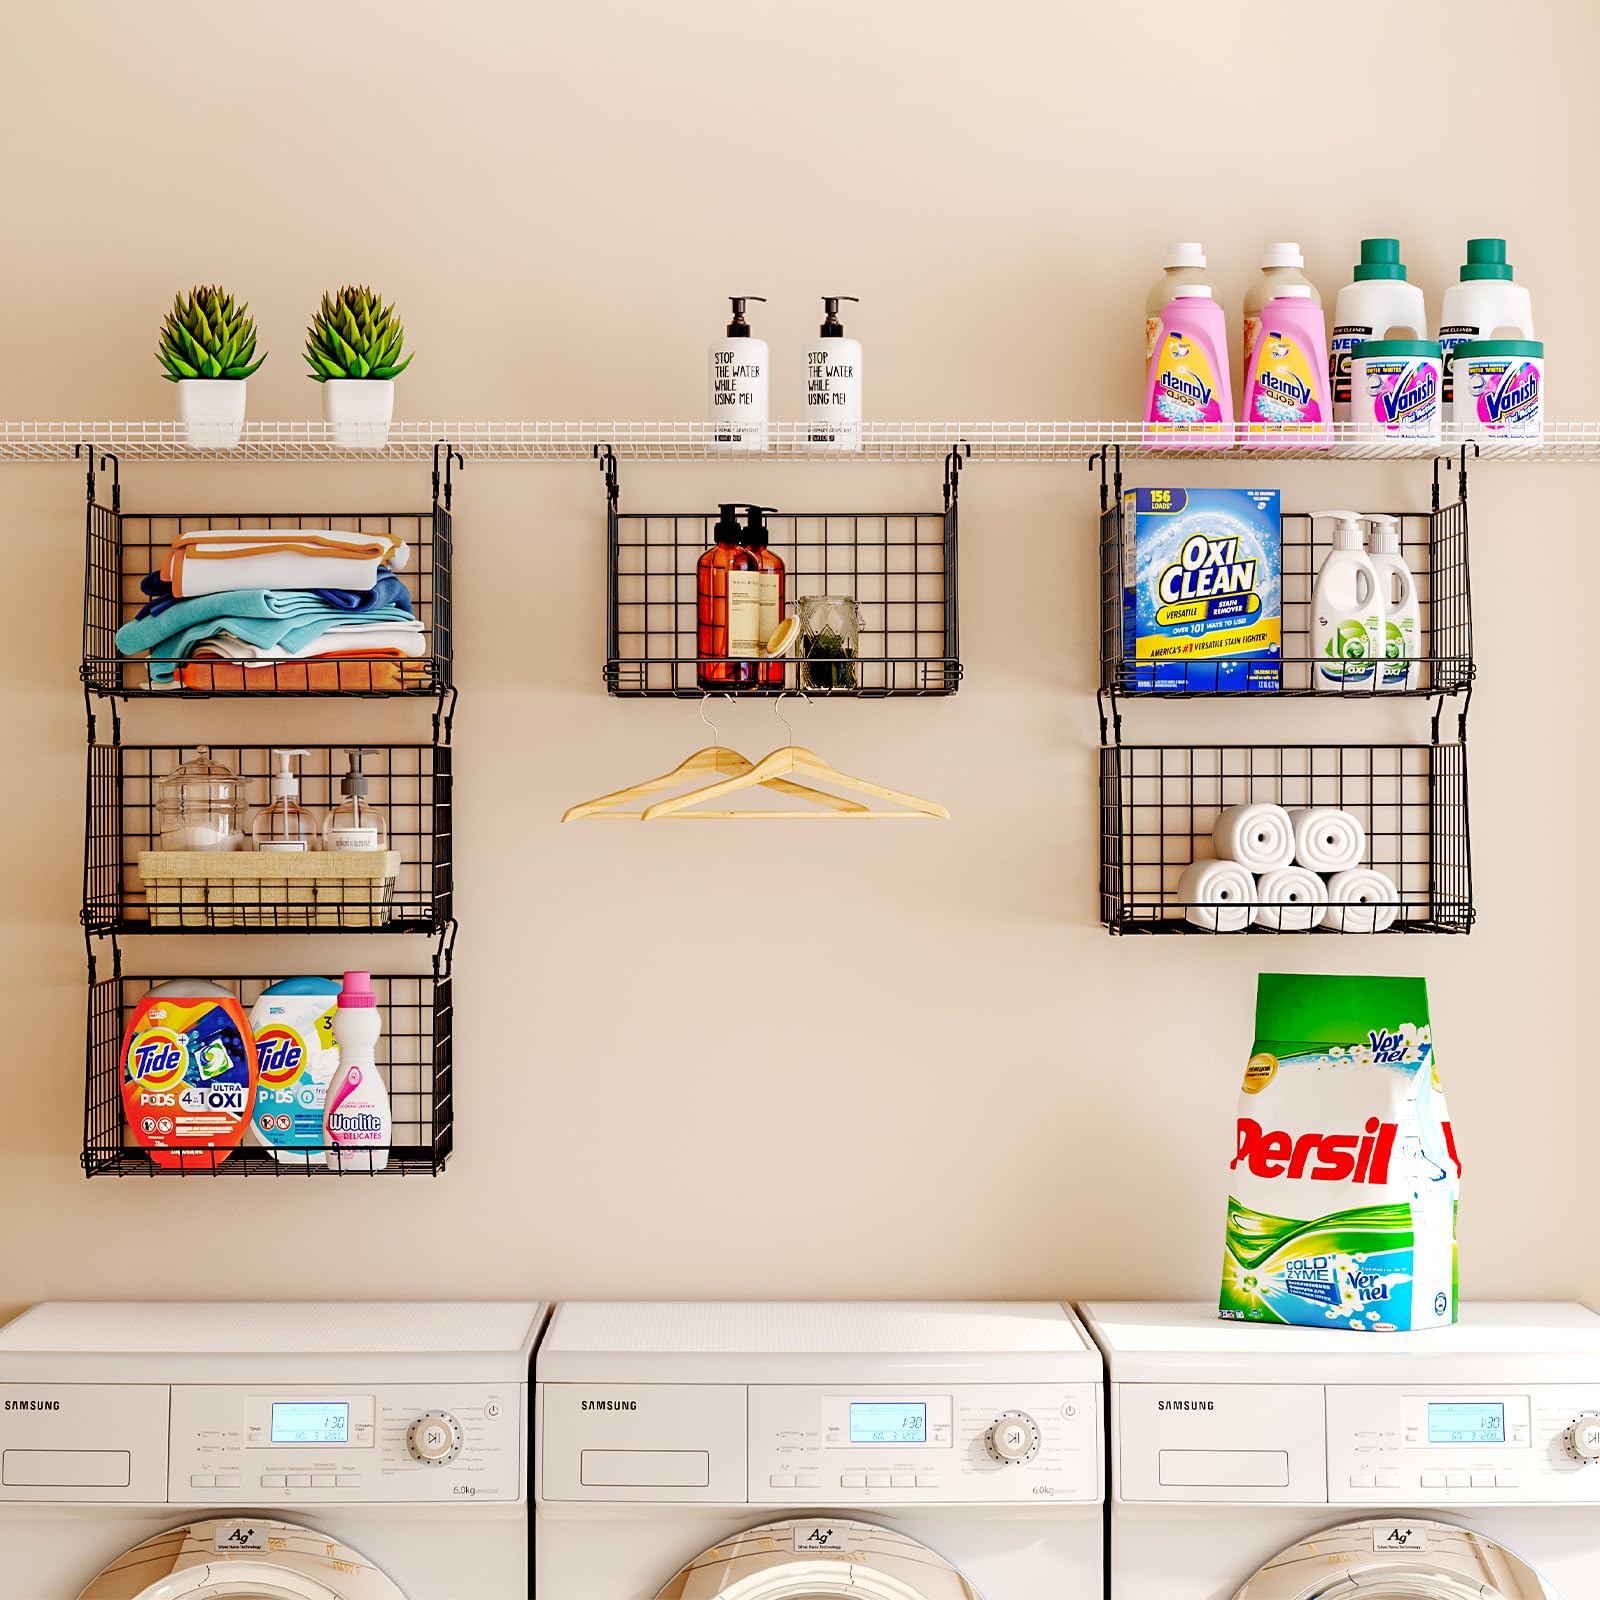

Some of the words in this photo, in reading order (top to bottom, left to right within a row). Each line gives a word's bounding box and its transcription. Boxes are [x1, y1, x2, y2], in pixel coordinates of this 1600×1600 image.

[714, 351, 735, 364] STOP
[808, 351, 828, 364] STOP
[715, 365, 729, 378] THE
[732, 365, 760, 378] WATER
[808, 365, 822, 378] THE
[826, 365, 853, 378] WATER
[714, 379, 736, 391] WHILE
[808, 379, 830, 391] WHILE
[714, 392, 736, 405] USING
[739, 392, 753, 405] ME!
[808, 392, 830, 405] USING
[832, 392, 846, 405] ME!
[1383, 370, 1435, 421] Vanish
[1486, 370, 1537, 421] Vanish
[1151, 490, 1171, 503] 156
[1182, 535, 1238, 571] OXI
[1160, 562, 1254, 603] CLEAN
[1166, 608, 1197, 619] VERSATILE
[1213, 605, 1243, 615] REMOVER
[1190, 623, 1205, 633] 101
[1206, 621, 1223, 629] WAYS
[1150, 646, 1182, 657] AMERICA'S
[1182, 644, 1193, 653] #1
[1194, 640, 1223, 651] VERSATILE
[1224, 637, 1241, 646] STAIN
[136, 1043, 181, 1079] Tide
[256, 1039, 302, 1075] Tide
[140, 1093, 175, 1106] PODS
[182, 1092, 192, 1104] 4
[208, 1092, 242, 1108] OXI
[329, 1113, 381, 1131] Woolite
[344, 1132, 382, 1140] DELICATES
[1230, 1116, 1398, 1185] Persil
[1286, 1256, 1328, 1271] COLD
[1287, 1269, 1329, 1281] ZYME
[1348, 1271, 1379, 1289] Ver
[1359, 1283, 1388, 1301] nel
[4, 1400, 60, 1411] SAMSUNG
[581, 1400, 637, 1411] SAMSUNG
[1158, 1400, 1214, 1411] SAMSUNG
